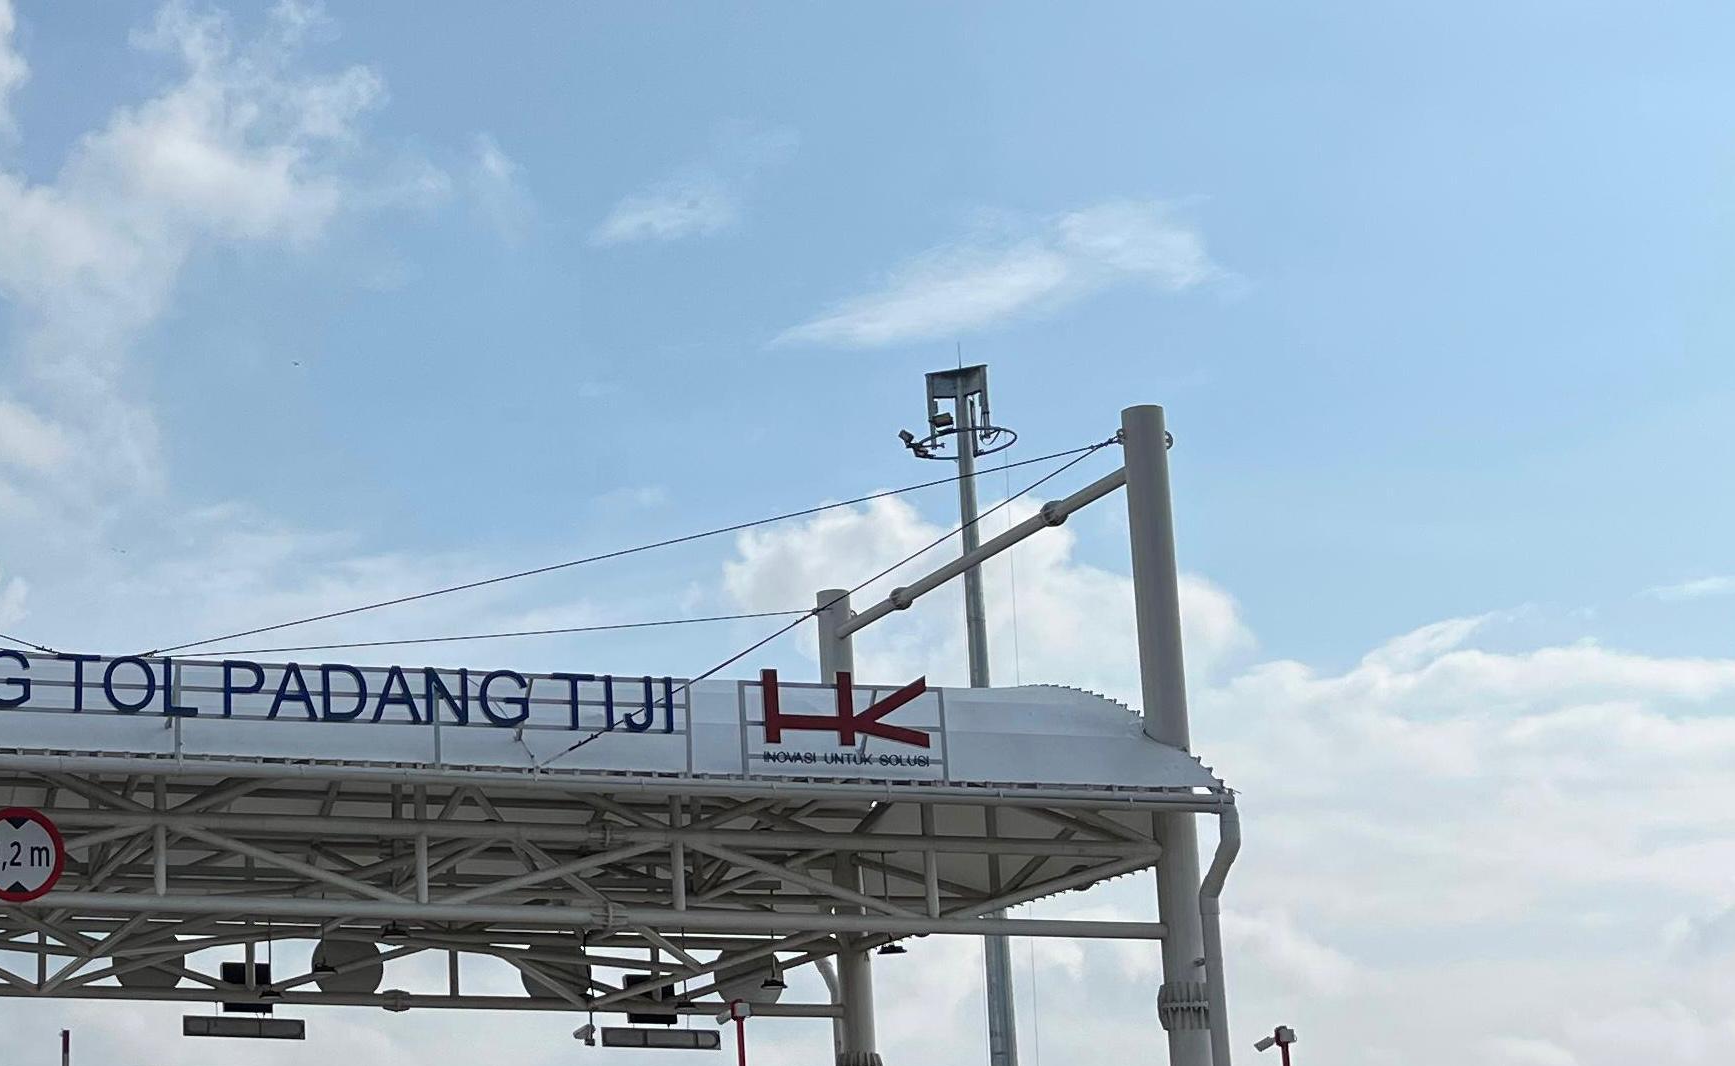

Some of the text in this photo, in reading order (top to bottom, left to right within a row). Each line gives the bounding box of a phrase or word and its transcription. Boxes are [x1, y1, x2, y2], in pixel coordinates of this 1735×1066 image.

[57, 653, 198, 718] TOL
[223, 659, 530, 730] PADANG
[551, 672, 676, 735] TIJI
[760, 668, 930, 749] HK
[763, 750, 931, 768] INOVASI UNTUK SOLUSI
[27, 844, 51, 868] m
